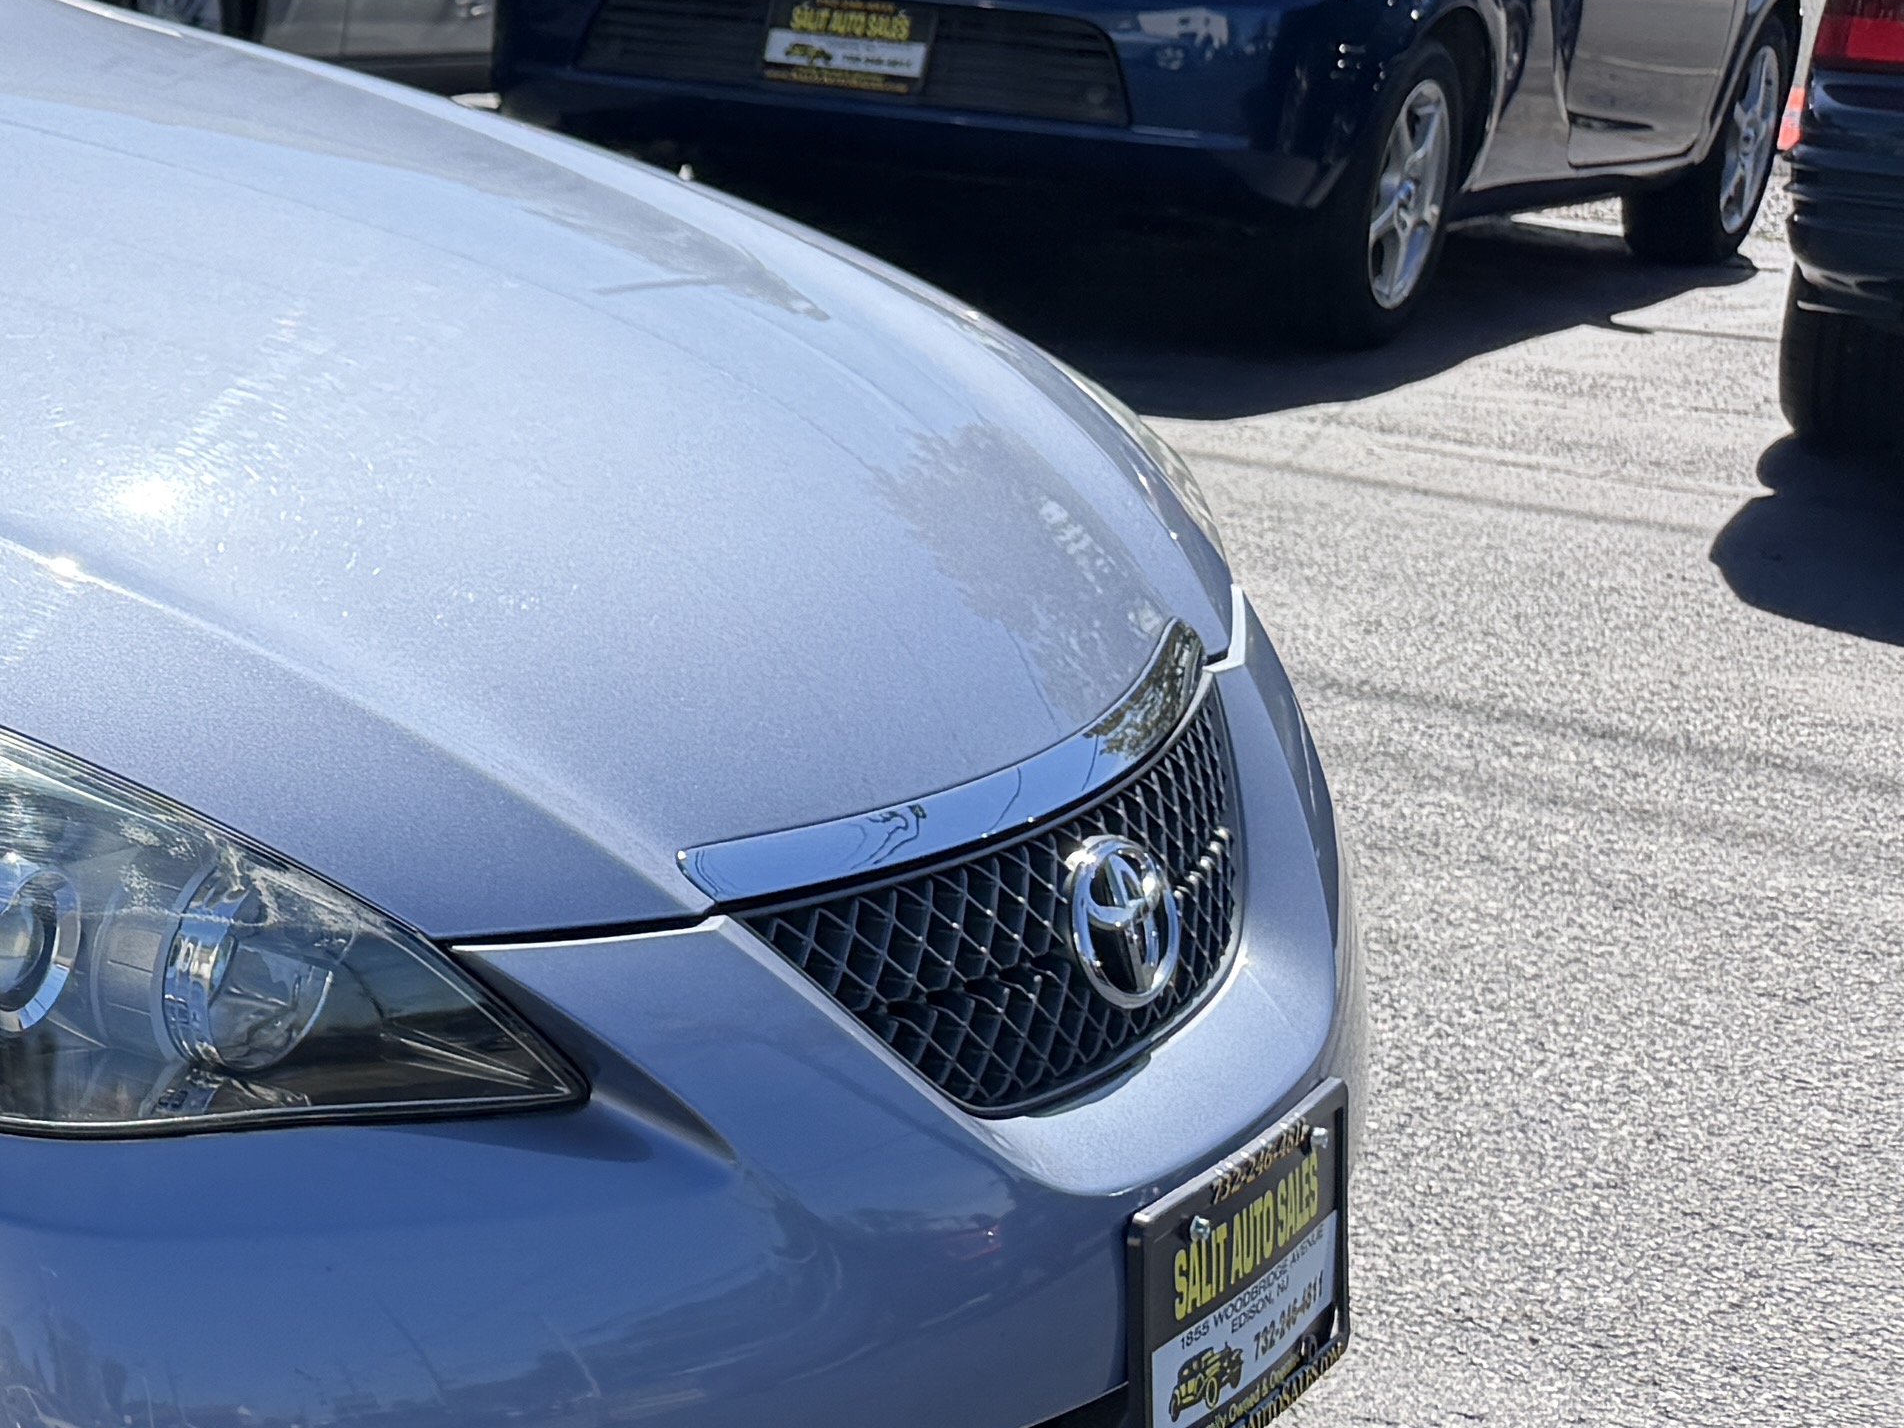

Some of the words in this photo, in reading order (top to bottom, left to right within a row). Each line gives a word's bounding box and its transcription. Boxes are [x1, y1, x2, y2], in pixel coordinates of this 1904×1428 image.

[1174, 1222, 1228, 1321] SALIT
[1231, 1189, 1274, 1285] AUTO
[1277, 1149, 1319, 1248] SALES
[1180, 1324, 1210, 1350] 1855
[1213, 1257, 1289, 1328] WOODBRIDGE
[1253, 1269, 1324, 1362] 732-246-4811
[1276, 1274, 1289, 1298] NJ
